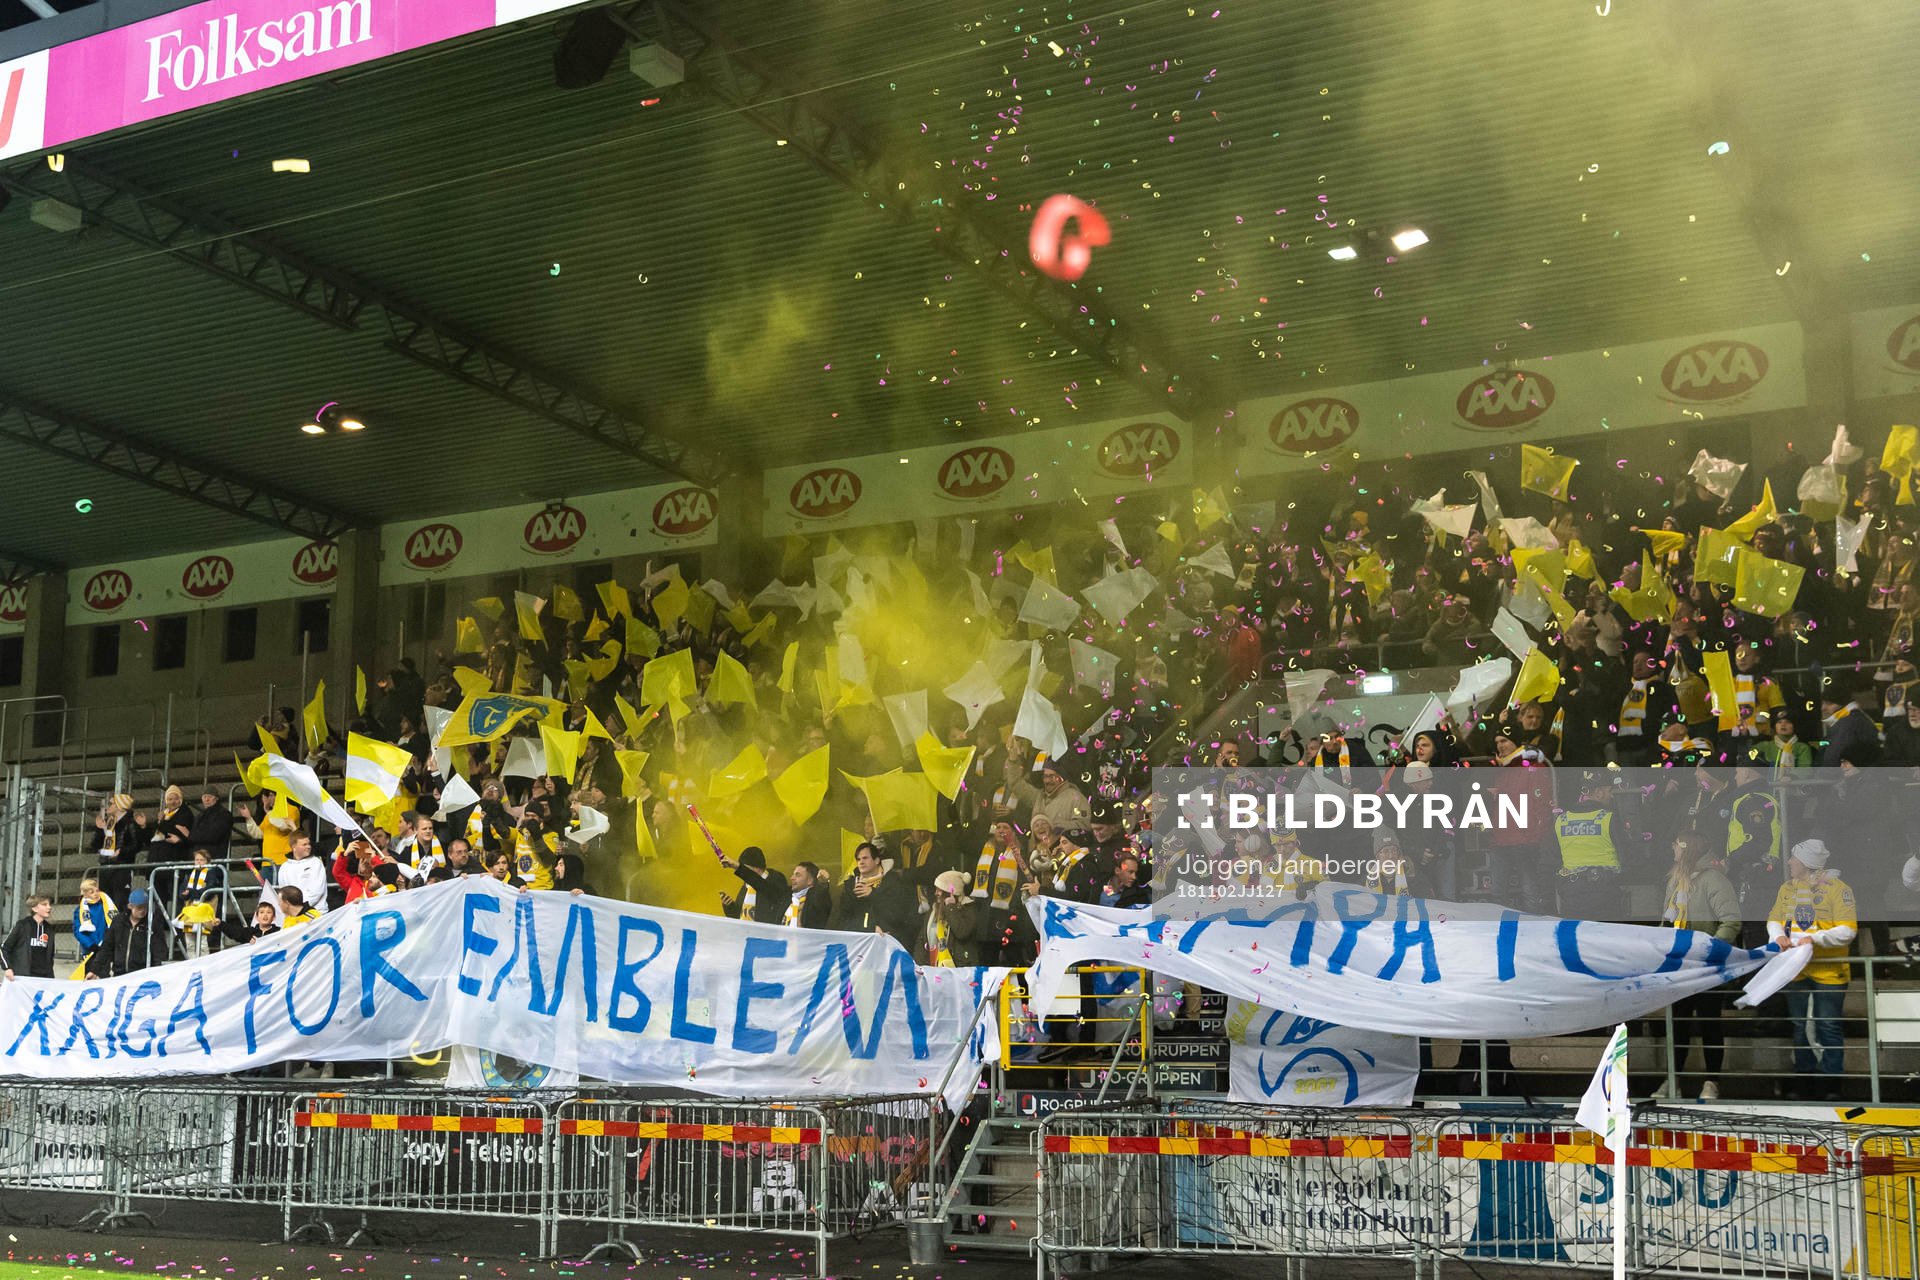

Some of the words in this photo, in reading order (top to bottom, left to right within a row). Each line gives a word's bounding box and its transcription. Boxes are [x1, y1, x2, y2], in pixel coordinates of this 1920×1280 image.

[141, 0, 374, 103] Folksam
[1671, 346, 1760, 391] AXA
[1465, 375, 1547, 418] AXA
[1276, 403, 1349, 441] AXA
[1104, 428, 1168, 465] AXA
[944, 452, 1008, 487] AXA
[794, 474, 853, 507] AXA
[657, 493, 713, 525] AXA
[529, 513, 582, 543] AXA
[409, 529, 457, 559] AXA
[88, 574, 127, 604] AXA
[186, 559, 230, 589] AXA
[0, 586, 26, 614] AX
[1564, 824, 1596, 836] POLIS
[5, 972, 211, 1059] KRIGA
[247, 909, 428, 1055] FÖR
[1121, 1044, 1220, 1057] ROGRUPPEN
[1100, 1072, 1201, 1085] O-GRUPPEN
[403, 1137, 446, 1166] opy
